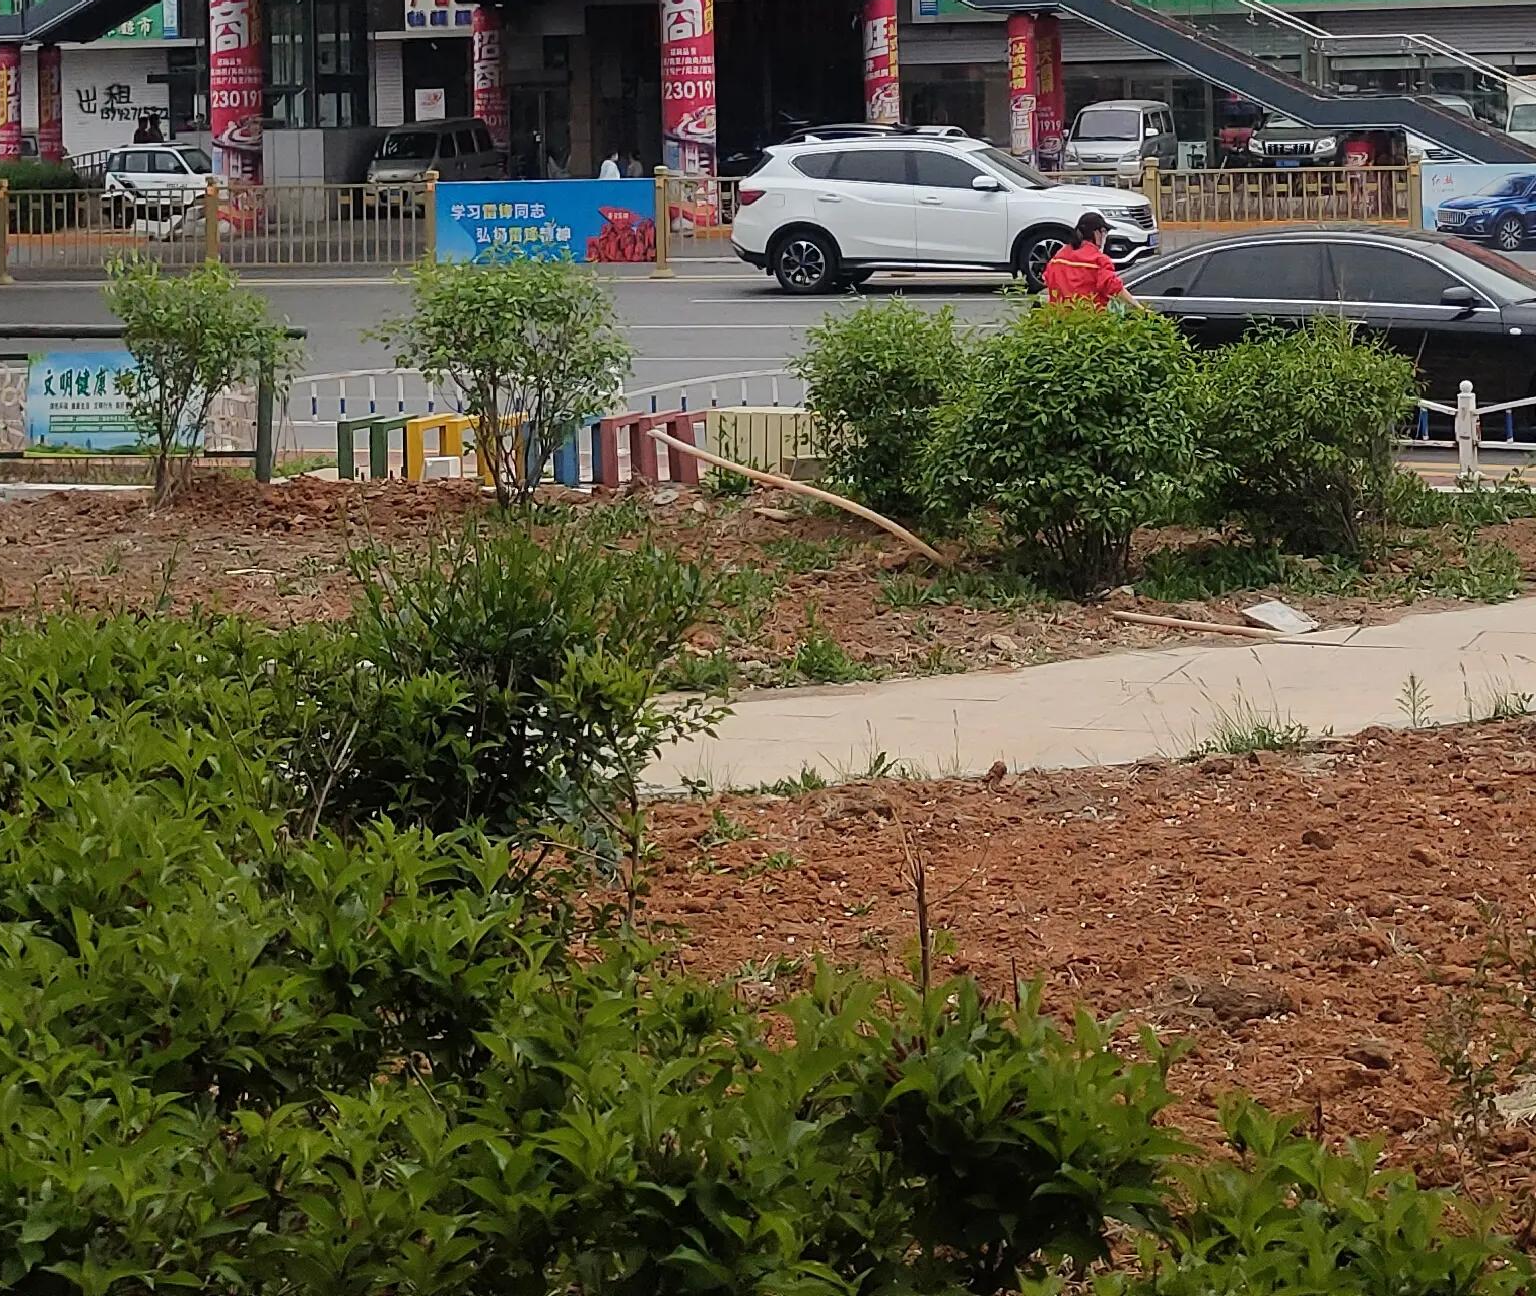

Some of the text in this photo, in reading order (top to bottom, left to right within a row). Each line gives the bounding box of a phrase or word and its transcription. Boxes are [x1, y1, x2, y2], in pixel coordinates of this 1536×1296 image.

[76, 83, 135, 115] 出租
[450, 203, 547, 221] 学习雷锋同志
[475, 226, 571, 243] 弘扬雷锋精神
